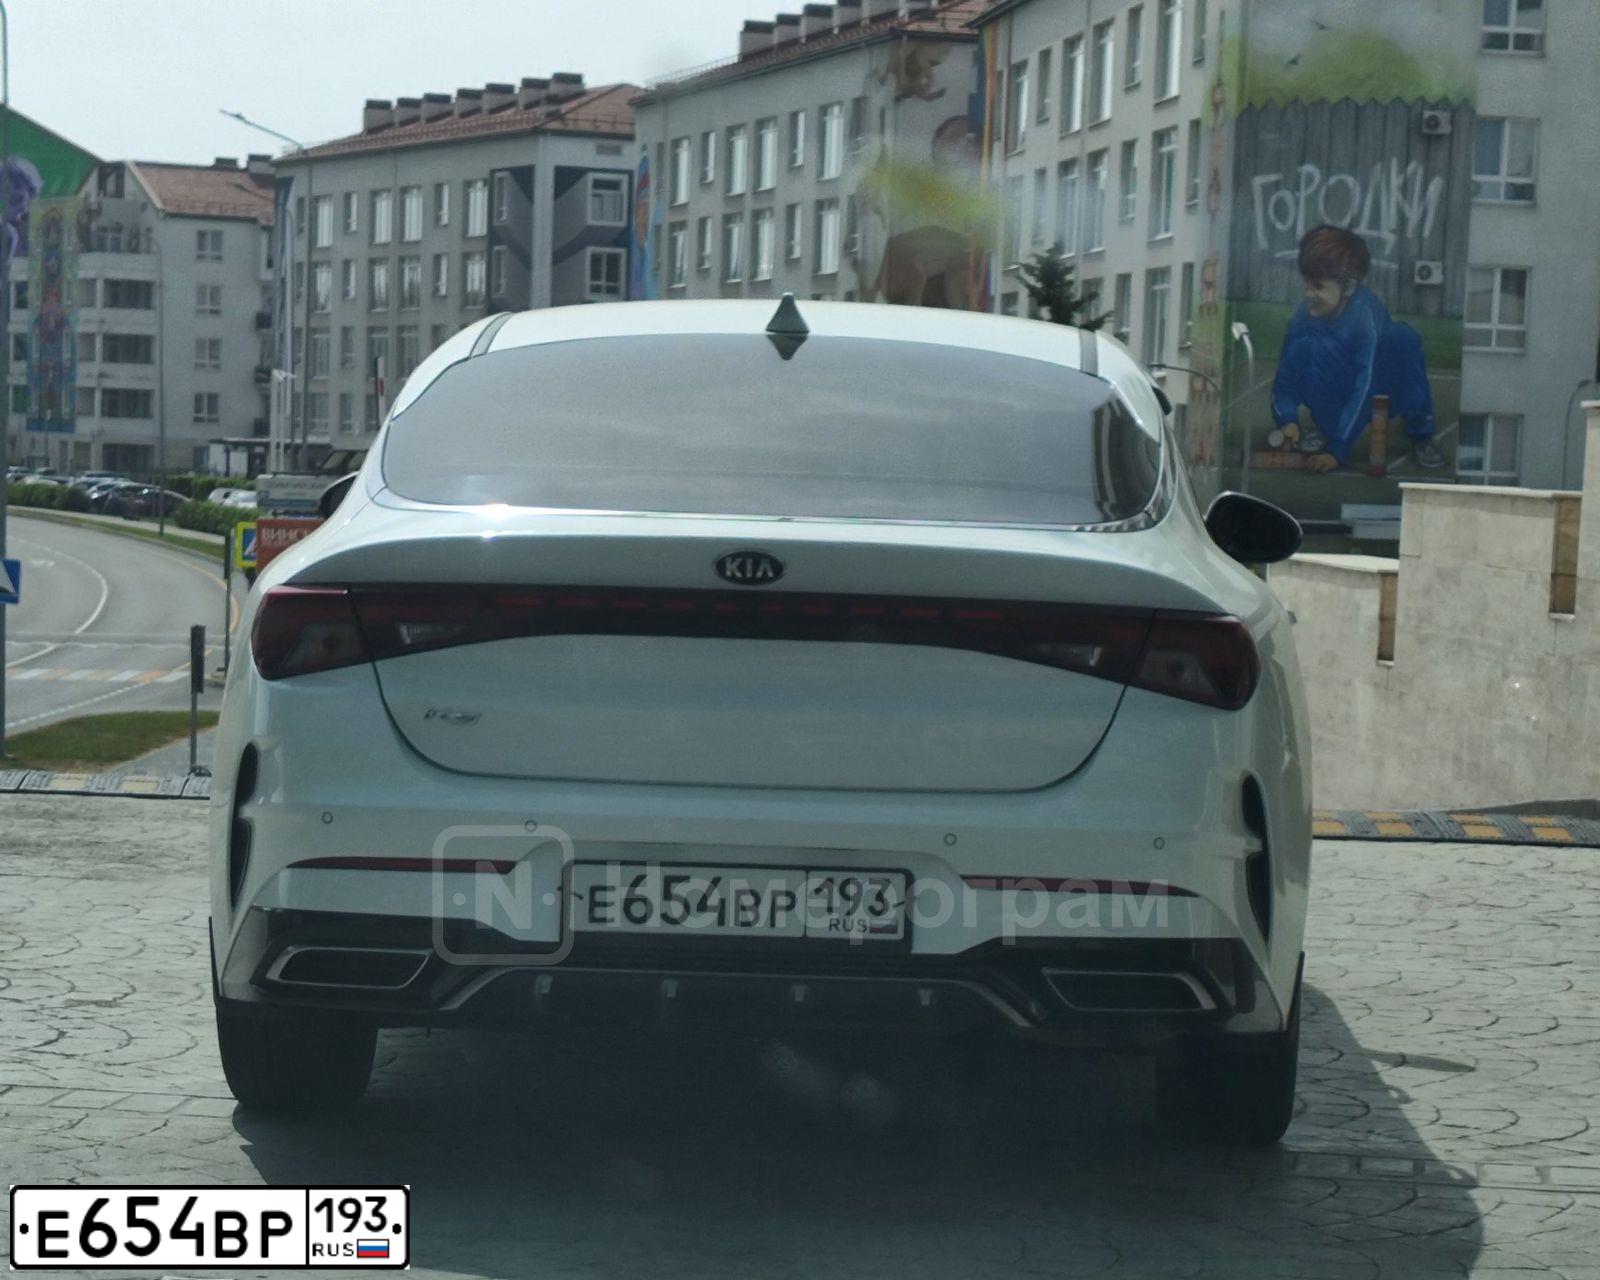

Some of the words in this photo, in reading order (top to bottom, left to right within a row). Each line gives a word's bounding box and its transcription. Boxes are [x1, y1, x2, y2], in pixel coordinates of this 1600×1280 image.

[725, 557, 775, 578] KIA
[588, 874, 797, 928] Е654ВР
[814, 877, 891, 916] 193
[828, 918, 868, 933] RUS
